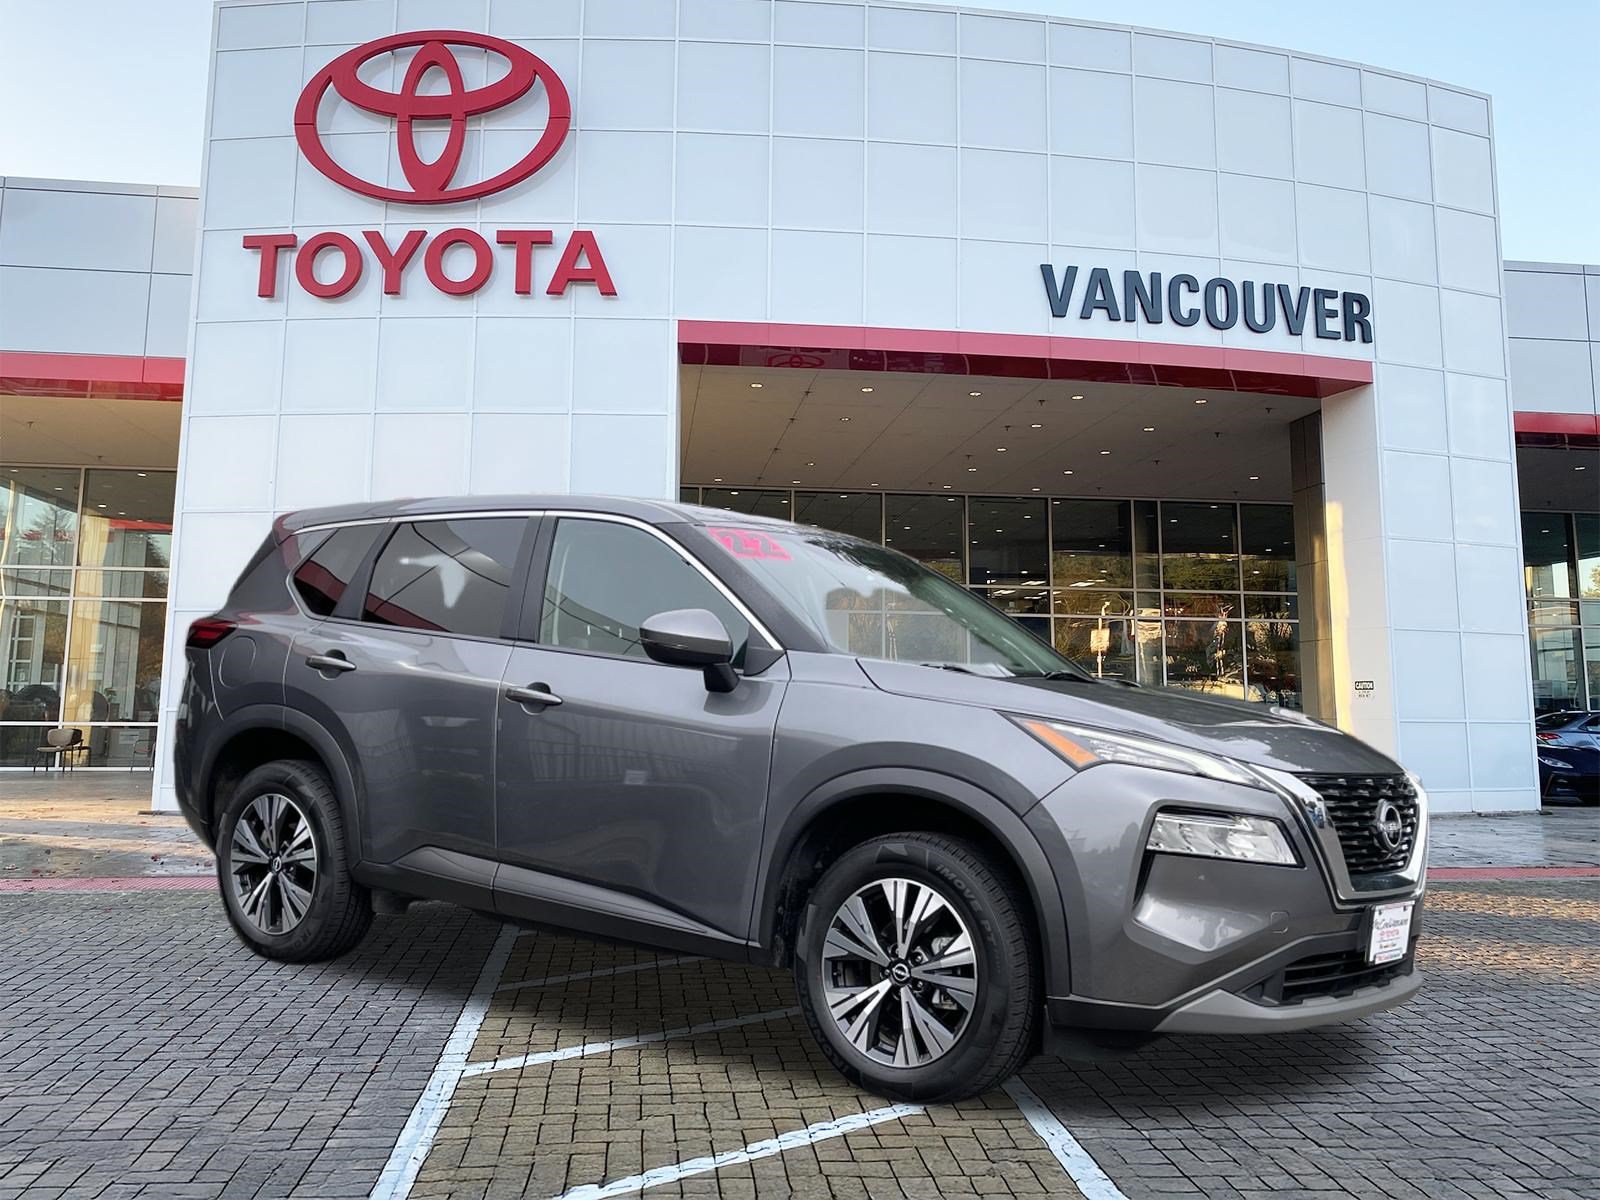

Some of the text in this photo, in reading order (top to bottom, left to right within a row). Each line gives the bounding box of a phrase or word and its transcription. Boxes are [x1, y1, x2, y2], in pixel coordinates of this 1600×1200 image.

[242, 227, 618, 299] TOYOTA
[1040, 263, 1373, 344] VANCOUVER
[714, 529, 789, 558] 22
